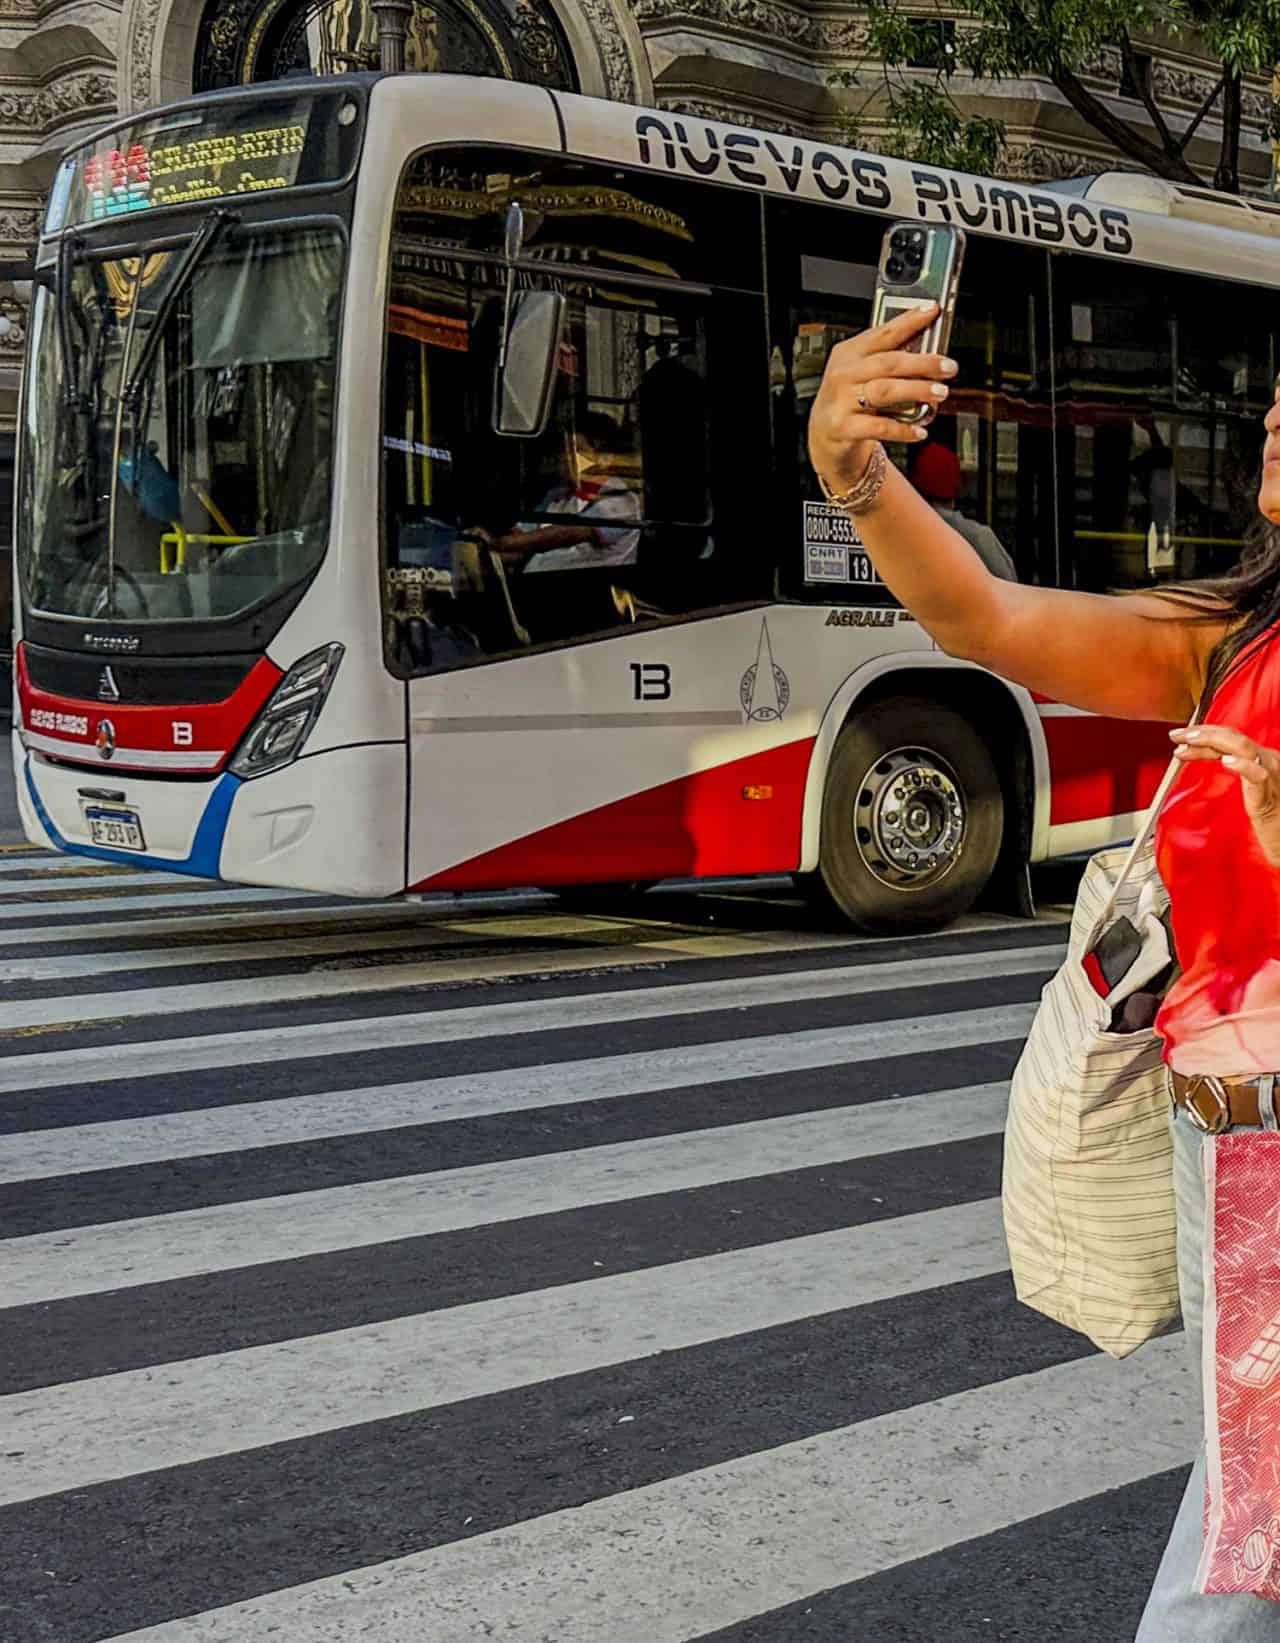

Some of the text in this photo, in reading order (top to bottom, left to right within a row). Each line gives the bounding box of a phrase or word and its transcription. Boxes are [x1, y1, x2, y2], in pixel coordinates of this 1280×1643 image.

[634, 115, 1134, 255] NUEVOS RUMBOS
[809, 547, 844, 558] CNRT
[852, 557, 869, 580] 13
[825, 610, 896, 627] AGRALE
[630, 663, 671, 700] 13
